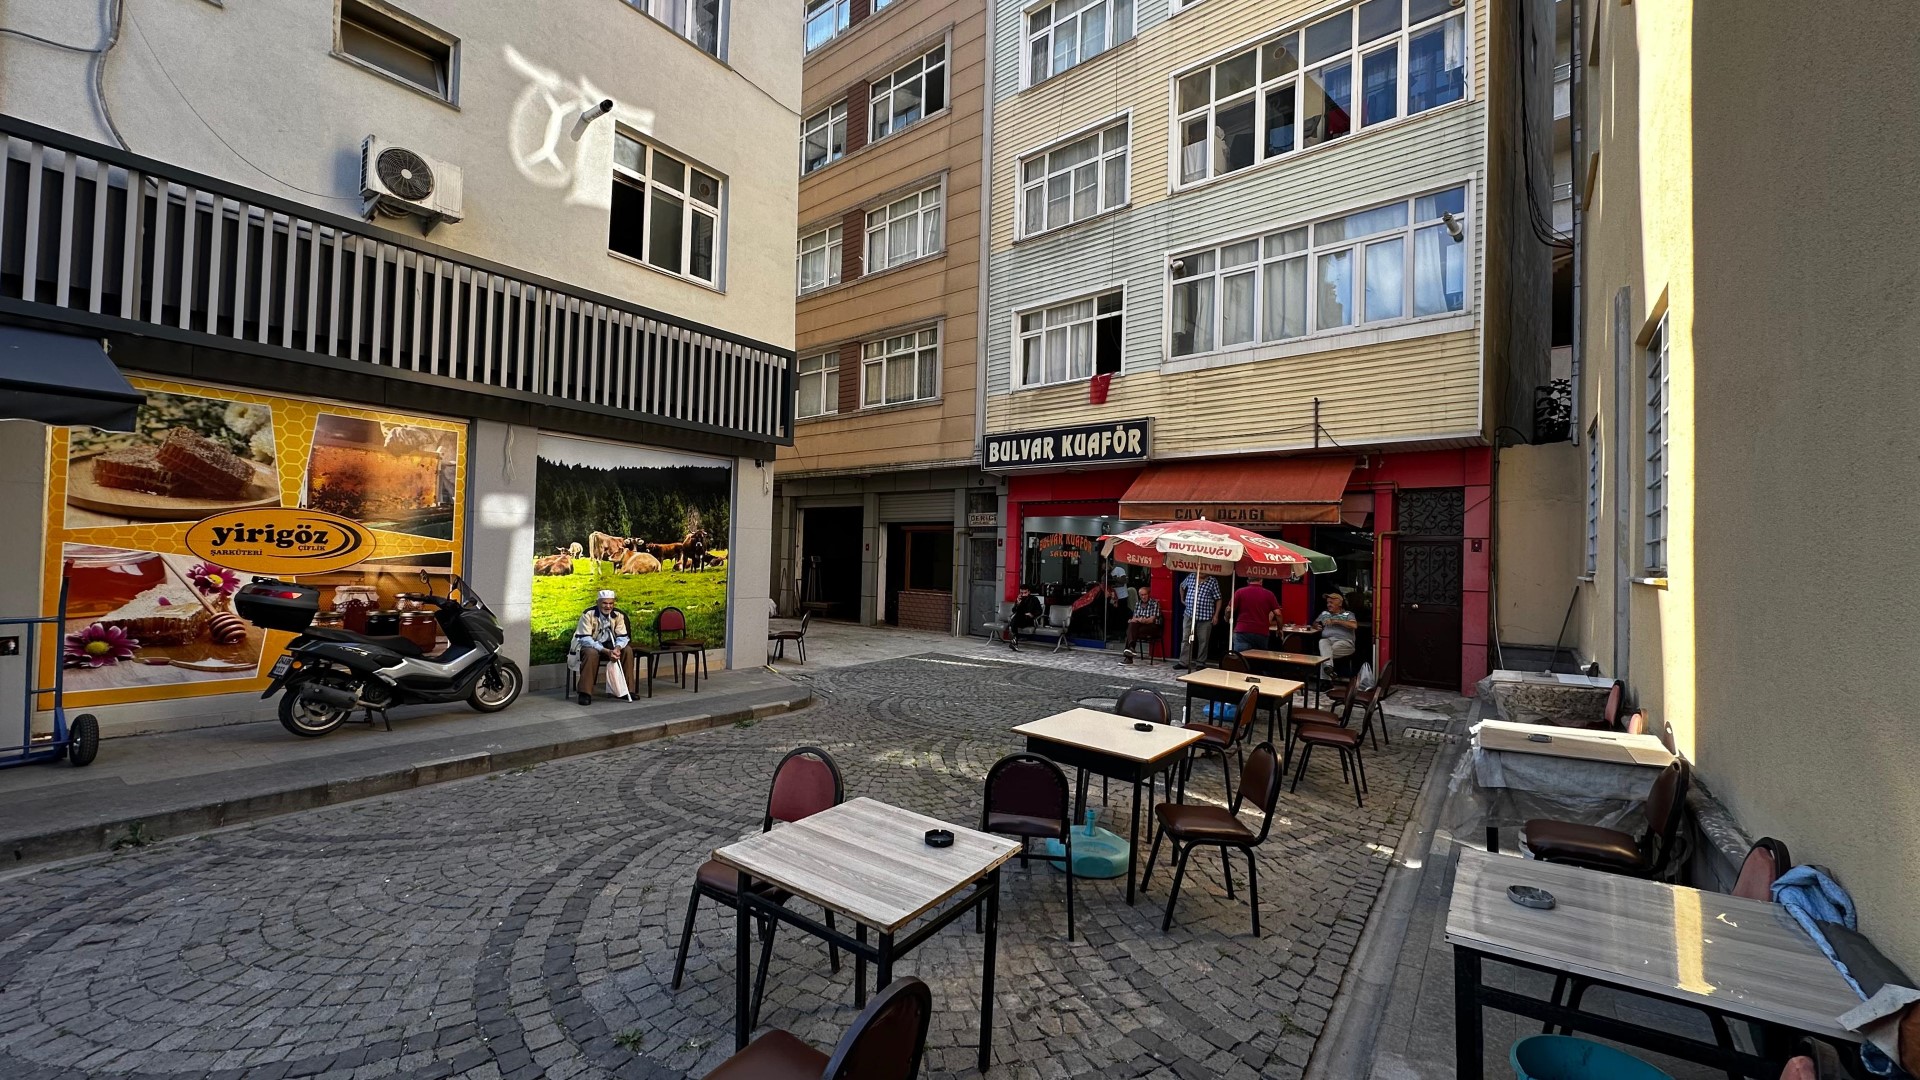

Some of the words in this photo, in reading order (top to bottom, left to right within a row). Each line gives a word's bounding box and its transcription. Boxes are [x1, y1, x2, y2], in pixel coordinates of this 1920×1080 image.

[989, 437, 1054, 462] BULVAR
[1061, 425, 1142, 458] KUAFÖR
[211, 522, 329, 549] yirigöz
[210, 548, 263, 557] ŞARKÜTERİ
